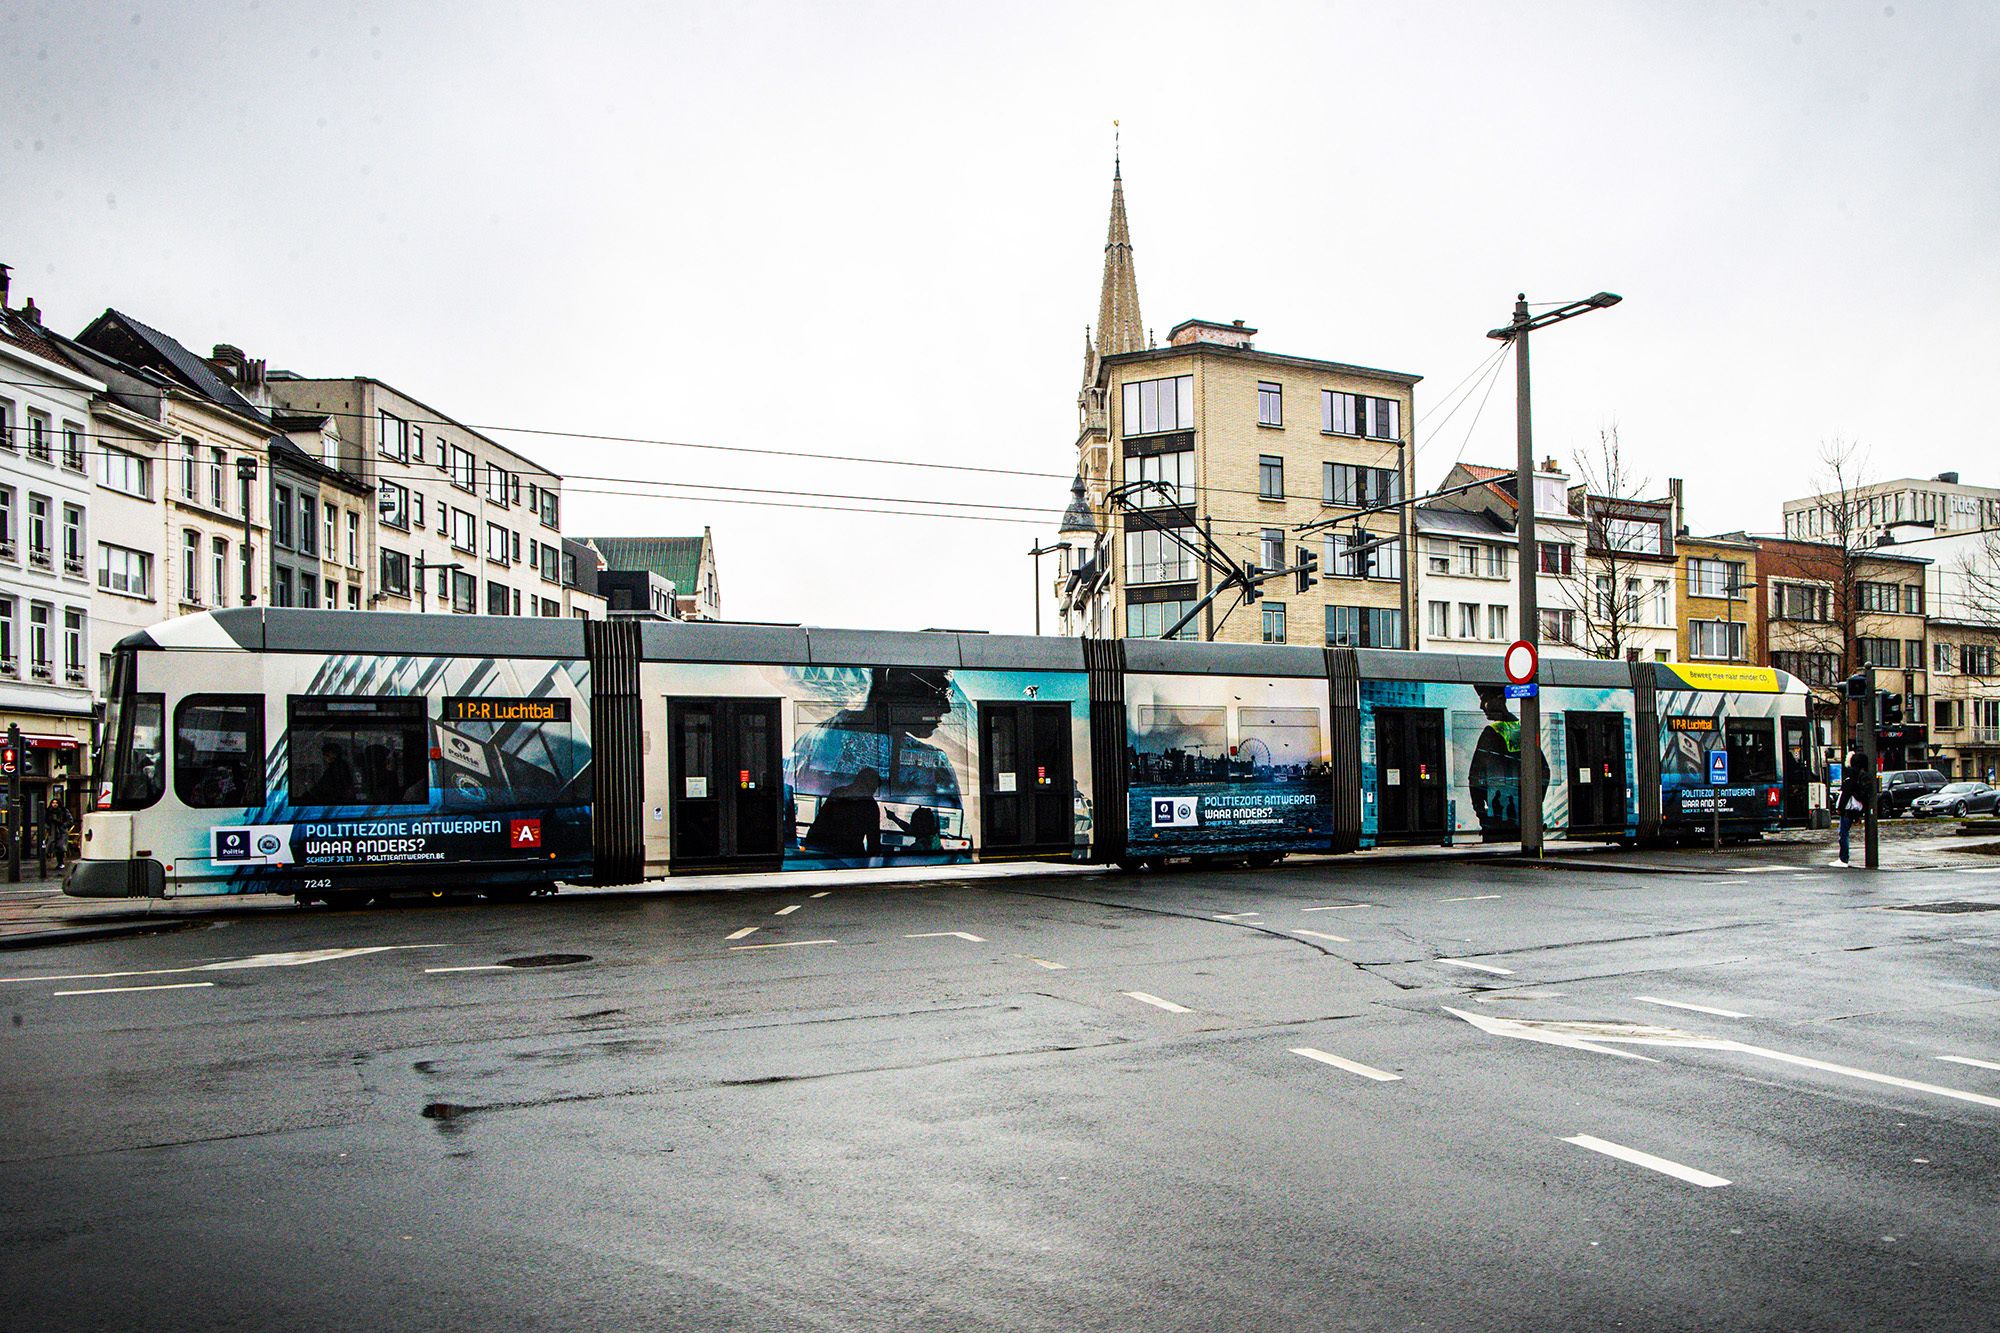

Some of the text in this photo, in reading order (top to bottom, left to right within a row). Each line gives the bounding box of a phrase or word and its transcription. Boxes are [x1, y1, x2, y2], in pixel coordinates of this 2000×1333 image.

[1690, 671, 1712, 680] Beweeg
[1713, 672, 1724, 680] mee
[1726, 672, 1738, 680] naar
[1740, 673, 1758, 681] minder
[457, 703, 554, 718] 1 P+R Luchtbal
[1687, 720, 1713, 730] Luchtbal
[1721, 788, 1755, 797] ANTWERPEN
[1770, 792, 1777, 802] A
[1205, 794, 1316, 807] POLITIEZONE ANTWERPEN
[1682, 799, 1700, 808] WAAR
[1205, 808, 1272, 820] WAAR ANDERS?
[306, 820, 501, 838] POLITIEZONE ANTWERPEN
[518, 825, 535, 842] A
[222, 848, 244, 856] Politie
[306, 838, 426, 855] WAAR ANDERS?
[306, 855, 335, 864] SCHRIJF
[366, 852, 445, 862] POLITIEANTWERPEN.BE
[304, 878, 332, 889] 7242
